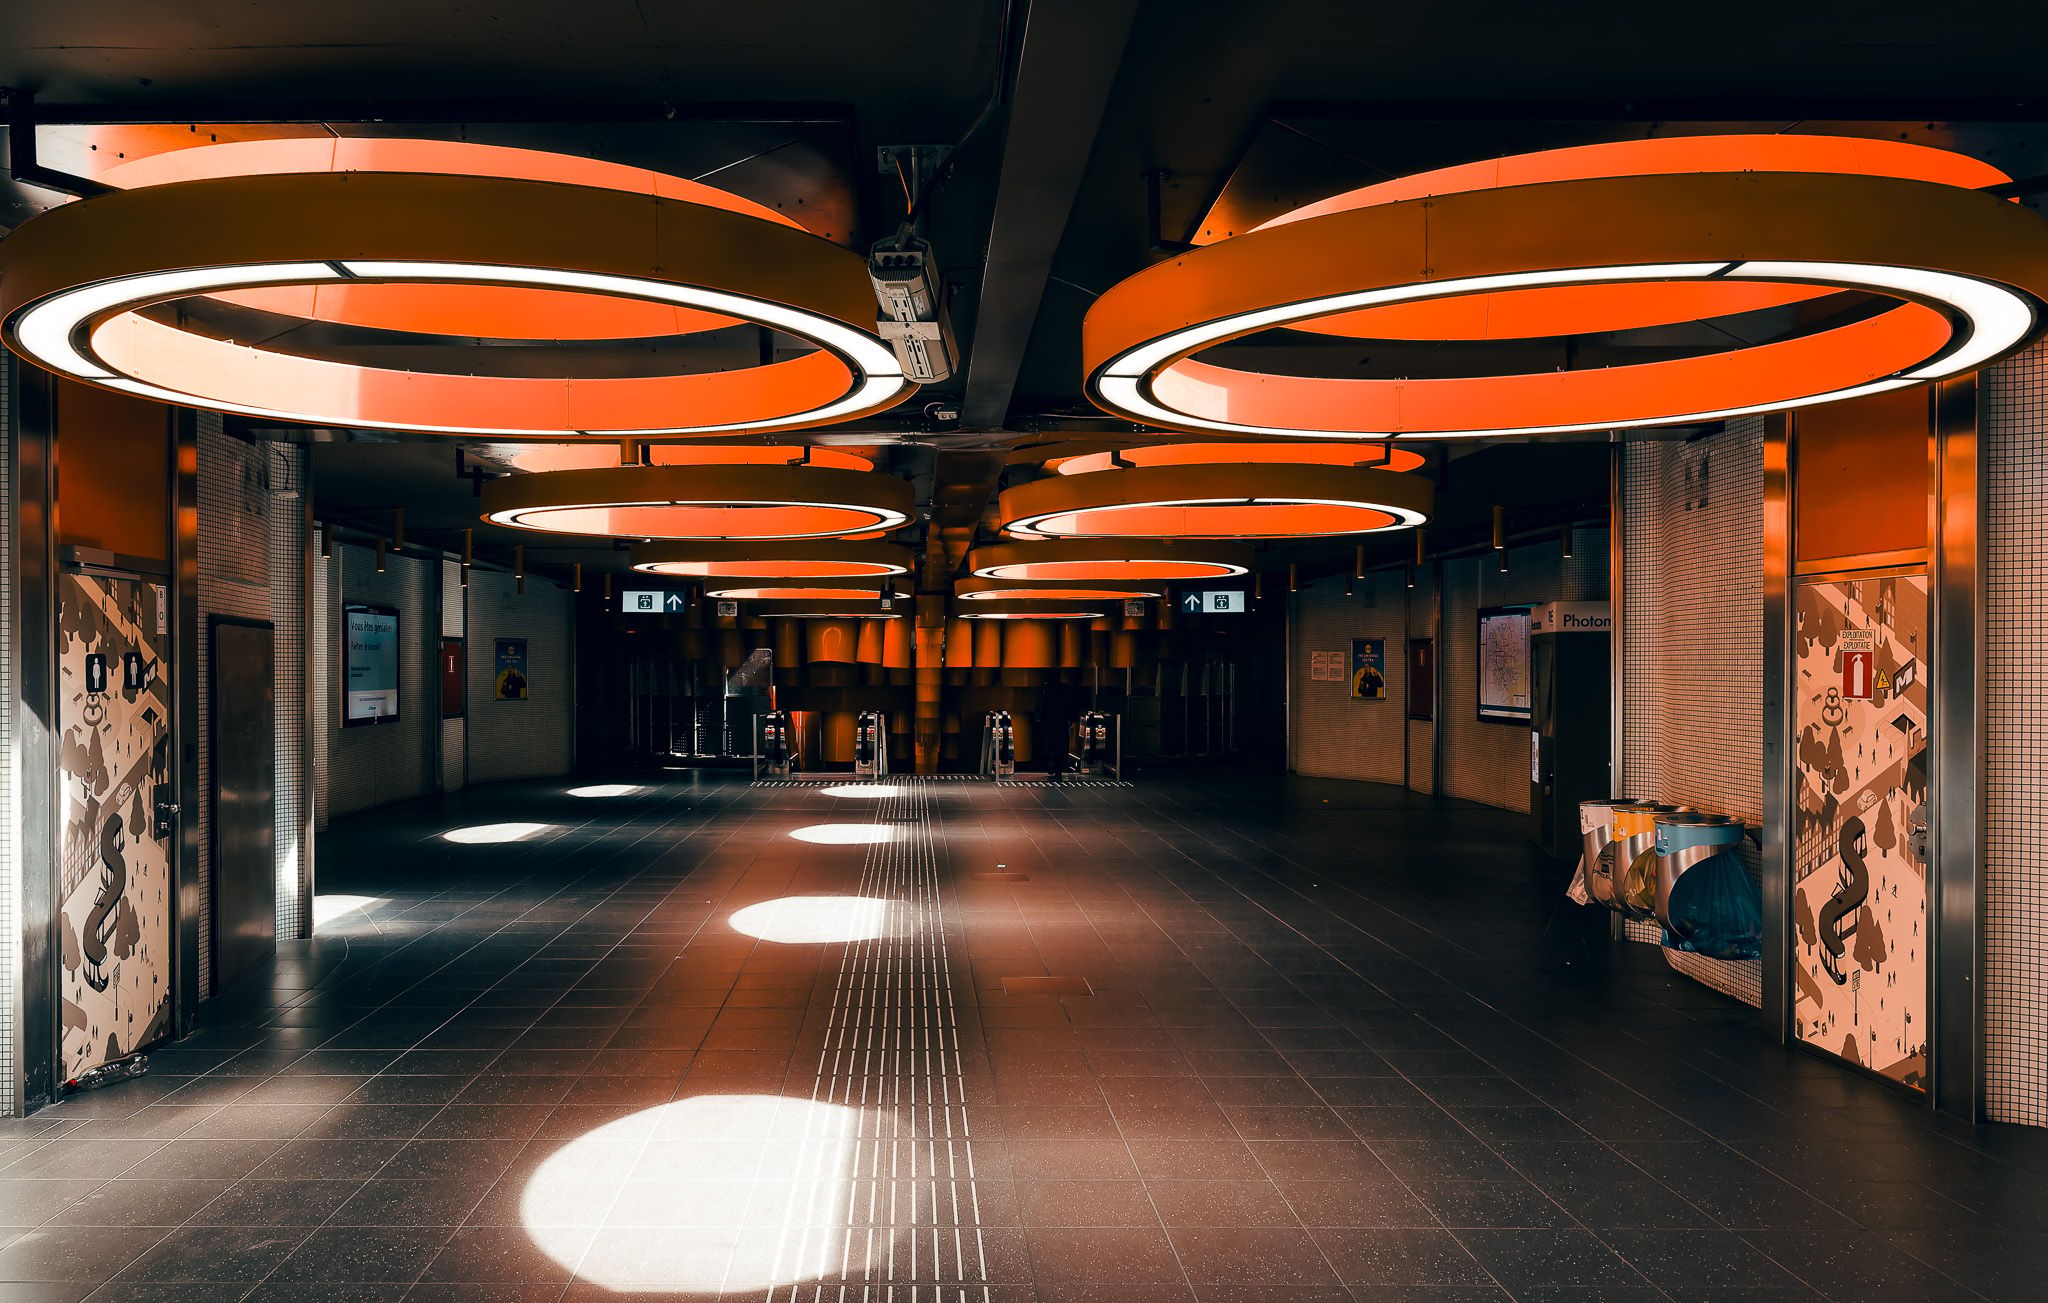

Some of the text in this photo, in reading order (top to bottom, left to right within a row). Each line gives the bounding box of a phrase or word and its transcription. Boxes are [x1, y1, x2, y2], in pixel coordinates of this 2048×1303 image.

[351, 620, 363, 631] Vous
[1842, 631, 1873, 639] EXPLOITATION
[1895, 666, 1913, 694] M
